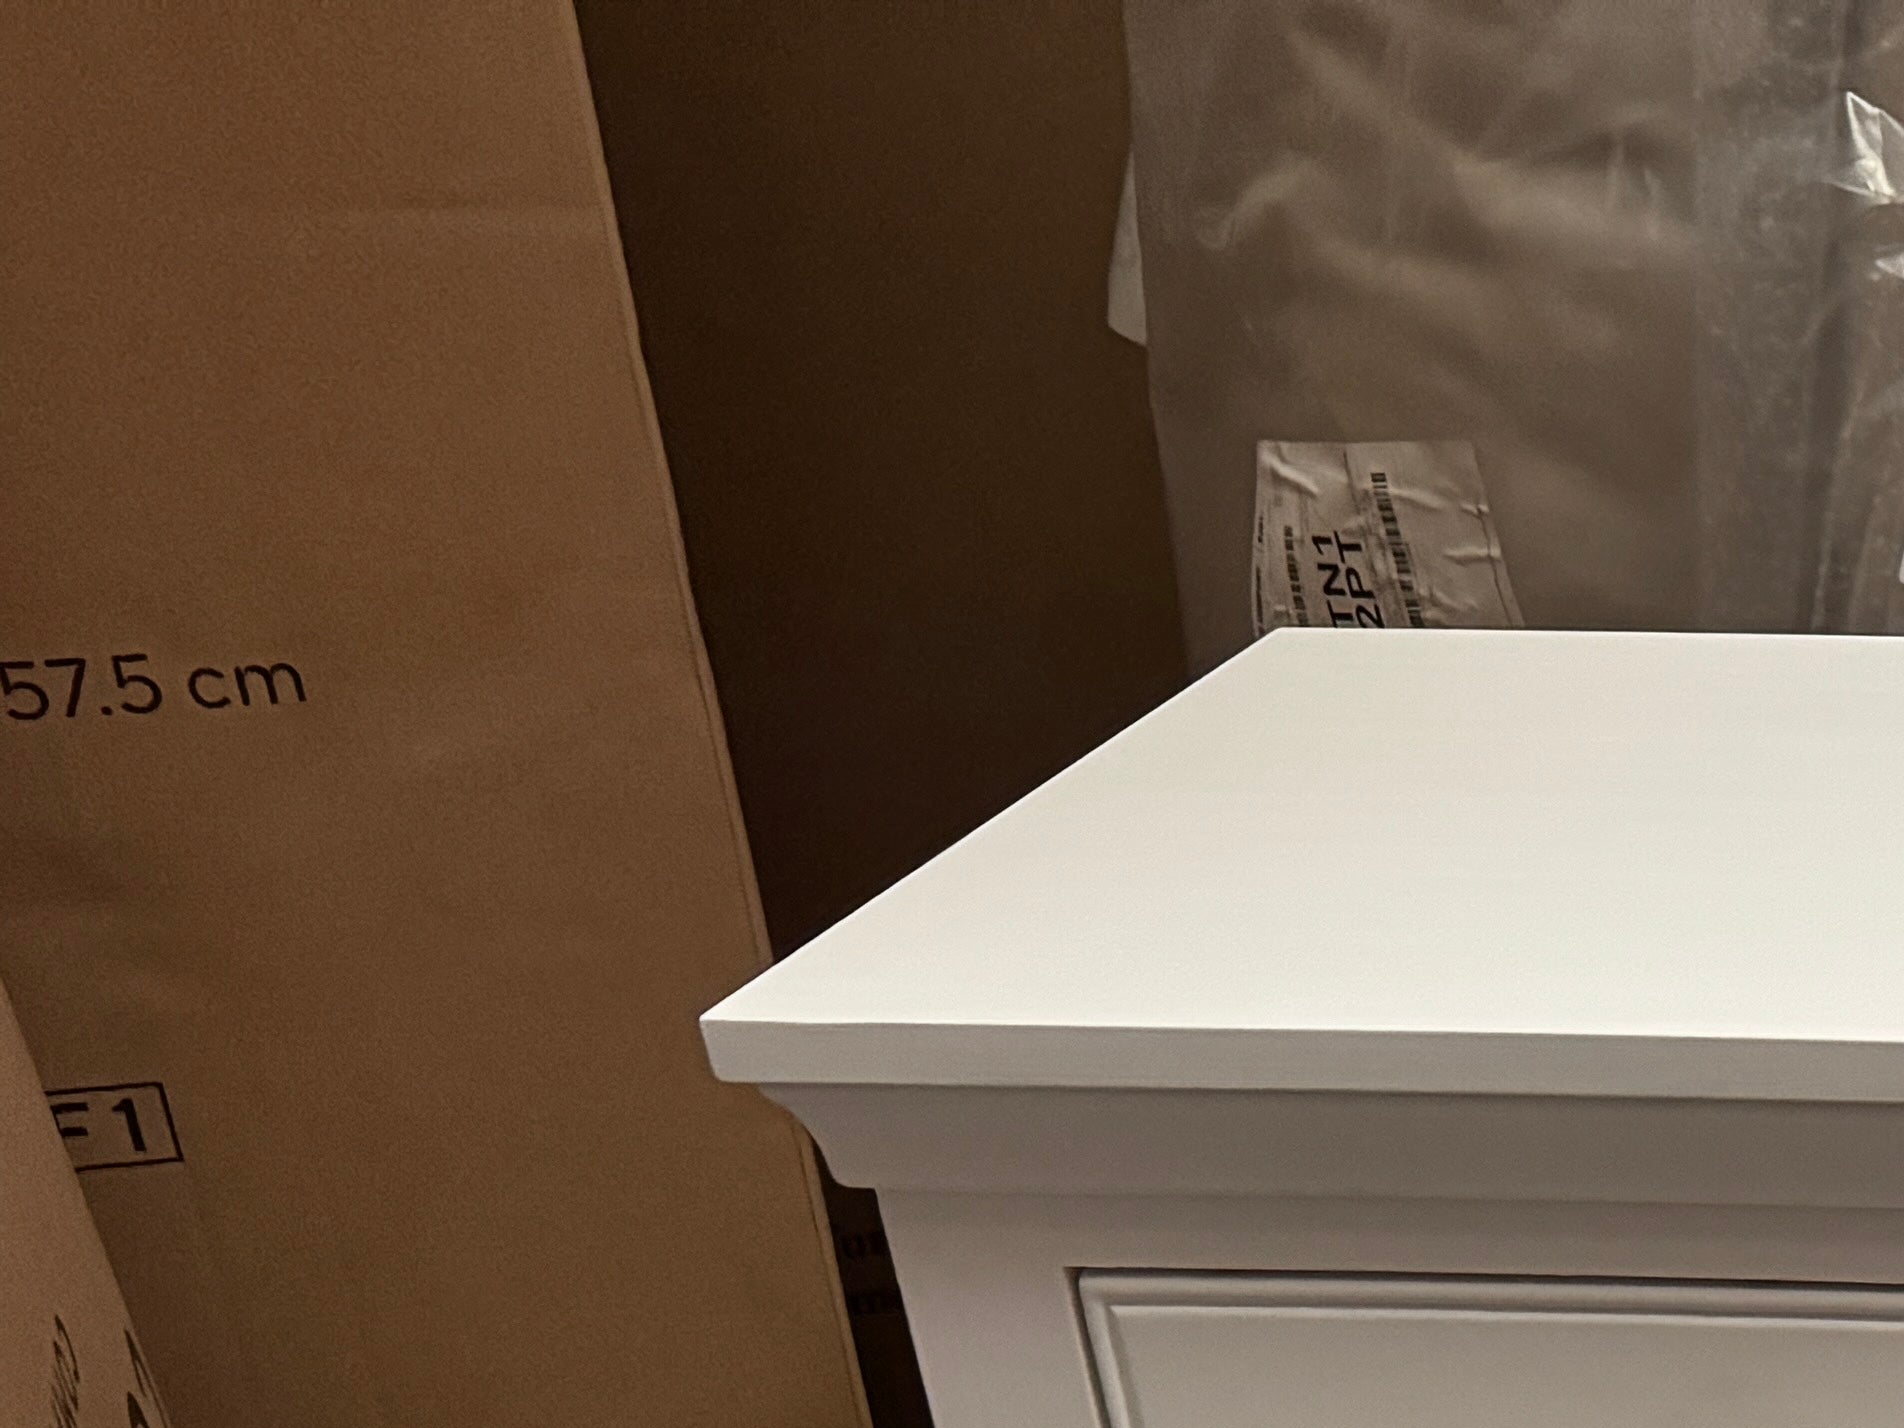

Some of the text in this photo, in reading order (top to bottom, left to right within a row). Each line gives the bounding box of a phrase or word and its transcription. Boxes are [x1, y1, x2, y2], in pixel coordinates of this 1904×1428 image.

[1311, 534, 1354, 627] TN1
[1334, 530, 1386, 628] 2PT
[0, 654, 308, 720] 57.5 cm
